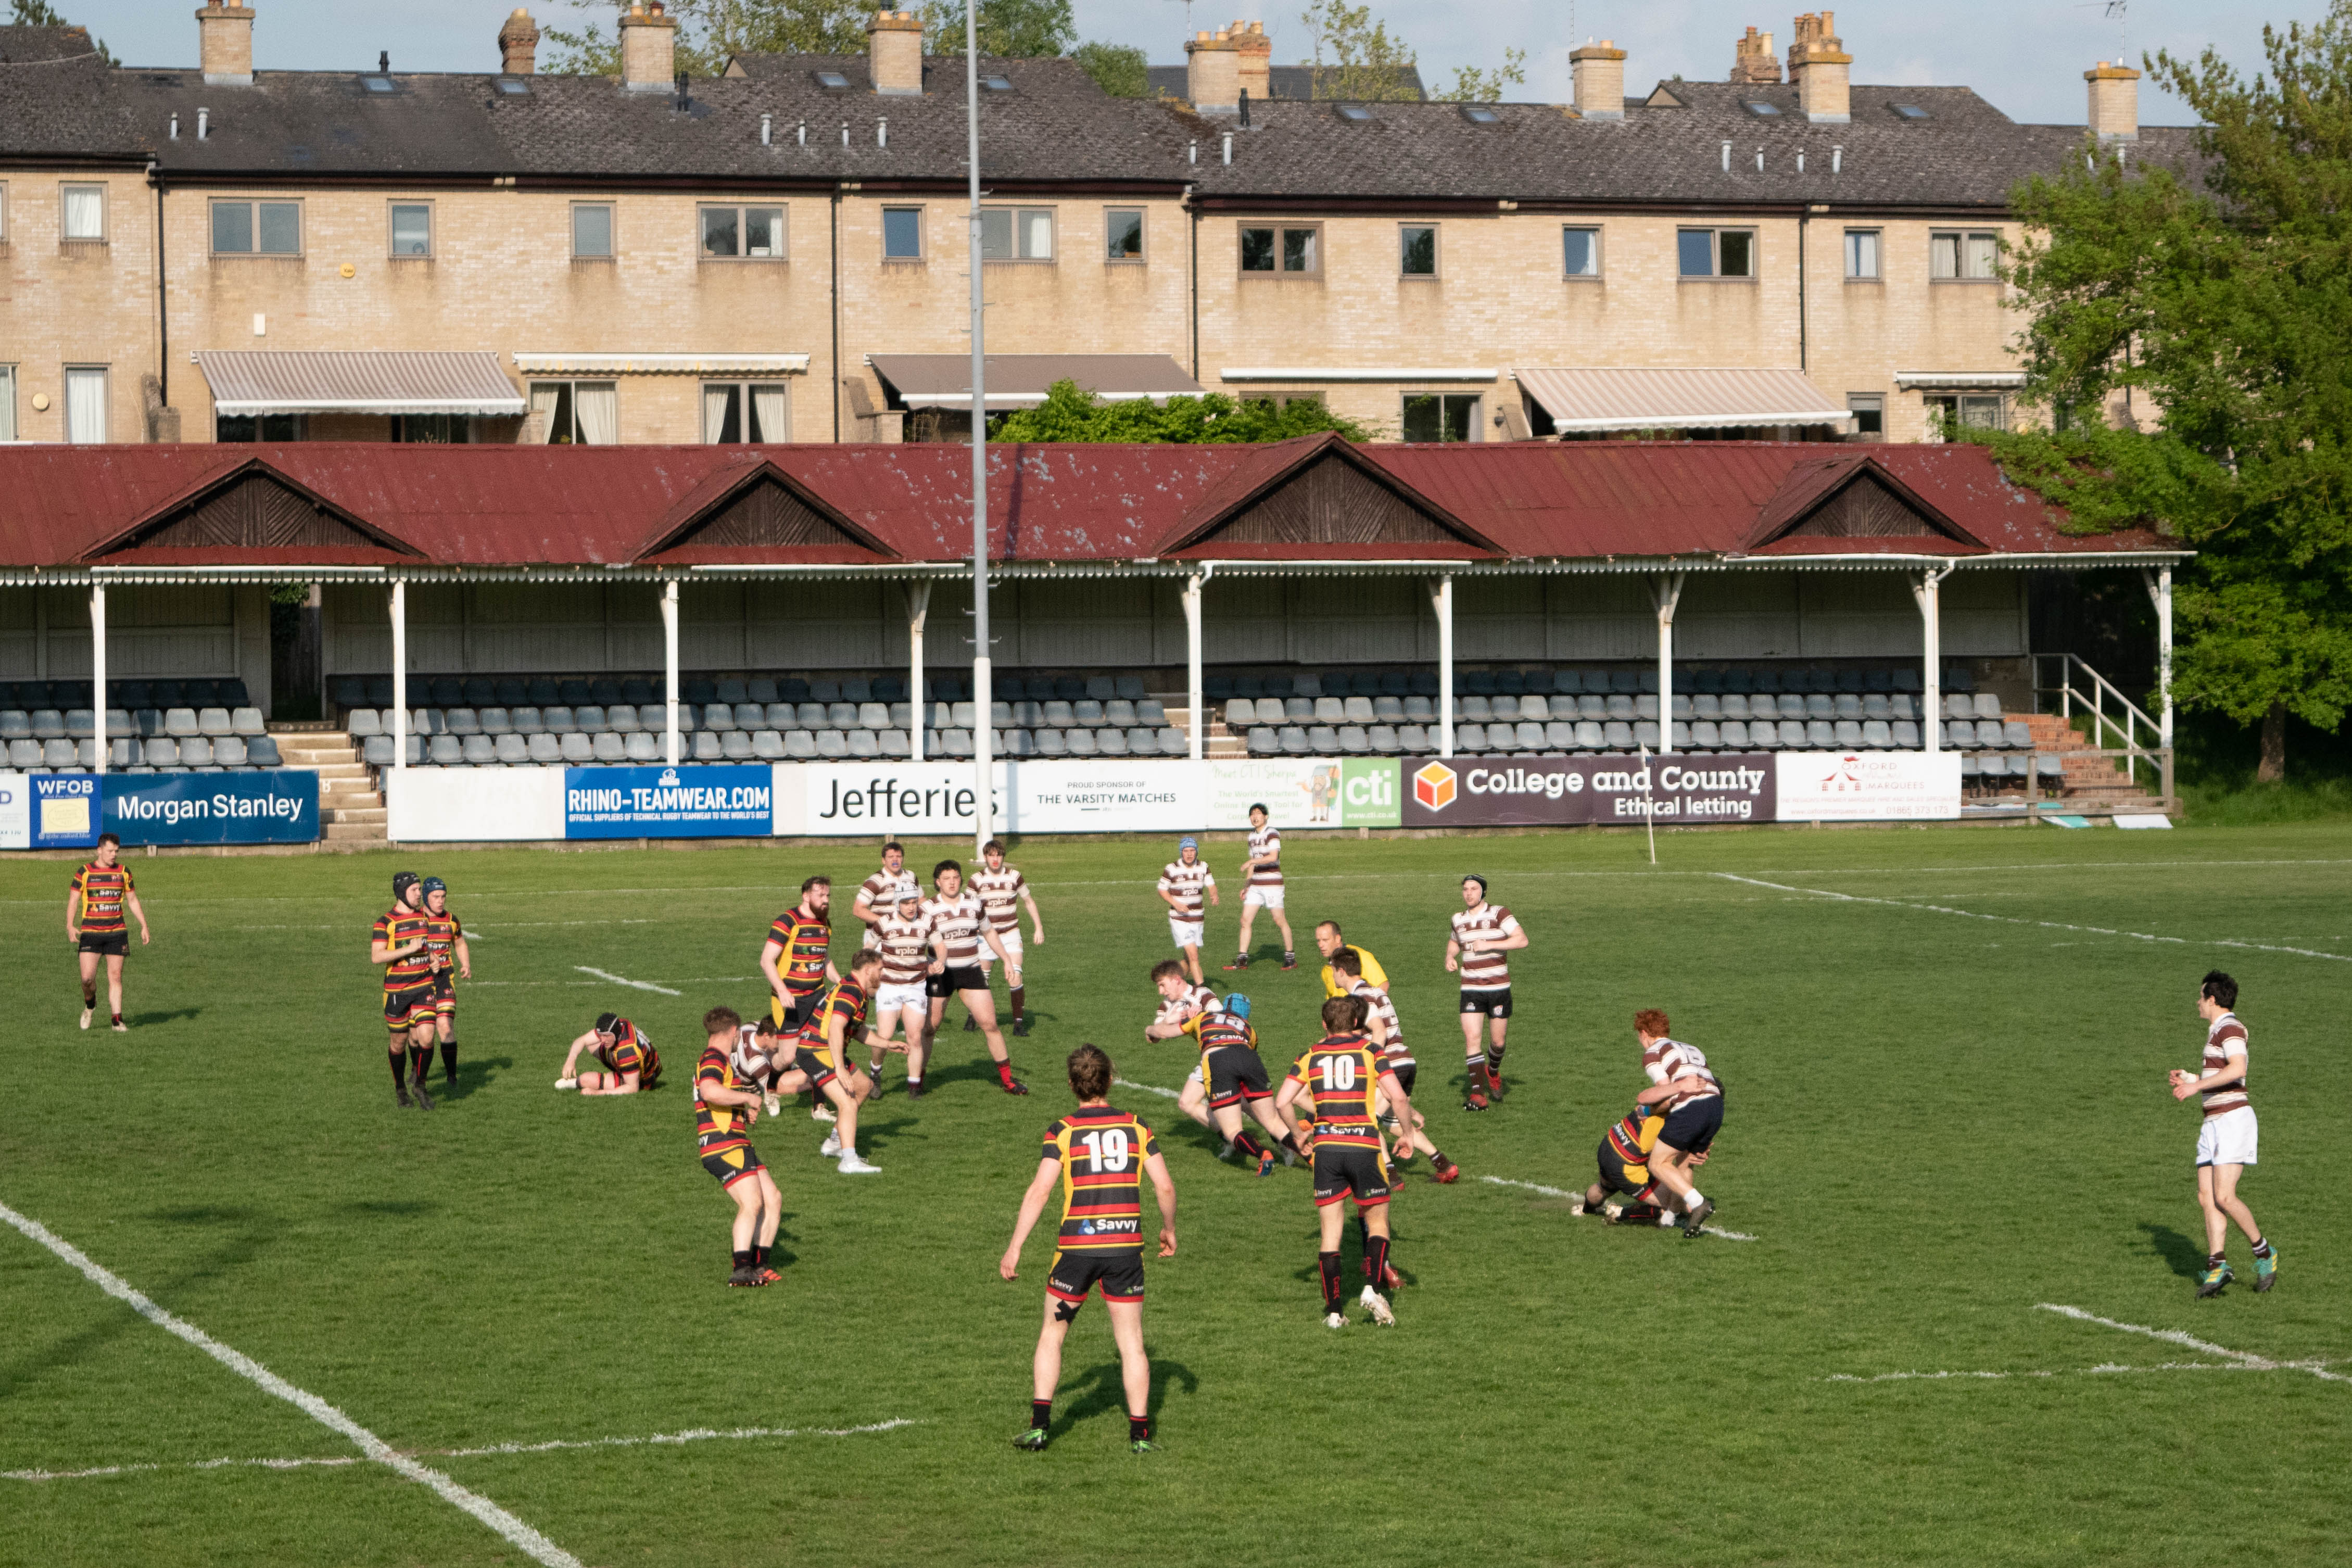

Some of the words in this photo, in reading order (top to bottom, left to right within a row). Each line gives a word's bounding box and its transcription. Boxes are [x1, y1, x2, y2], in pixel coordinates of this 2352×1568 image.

[1241, 764, 1260, 778] CTI
[1265, 763, 1296, 783] Sherpa
[1466, 768, 1584, 799] College
[1592, 767, 1653, 791] and
[1660, 765, 1765, 794] County
[37, 780, 94, 794] WFOB
[1346, 769, 1392, 805] cti
[568, 786, 769, 812] RHINO-TEAMWEAR.COM
[1037, 794, 1061, 803] THE
[1066, 794, 1115, 803] VARSITY
[1119, 793, 1176, 803] MATCHES
[1615, 796, 1680, 816] Ethical
[1686, 796, 1752, 818] letting
[118, 795, 208, 825] Morgan
[212, 793, 303, 822] Stanley
[569, 814, 593, 822] OFFICIAL
[595, 813, 624, 821] SUPPLIERS
[662, 812, 681, 820] RUGBY
[682, 812, 712, 820] TEAMWEAR
[731, 811, 755, 819] WORLD'S
[756, 811, 769, 819] BEST
[99, 904, 120, 912] Savvy
[1318, 1055, 1355, 1090] 10
[1216, 1090, 1232, 1098] Savvy
[1330, 1126, 1365, 1136] Savvy
[1614, 1122, 1631, 1146] Savvy
[1082, 1129, 1128, 1172] 19
[1096, 1219, 1137, 1233] Savvy
[1054, 1279, 1073, 1292] Savvy
